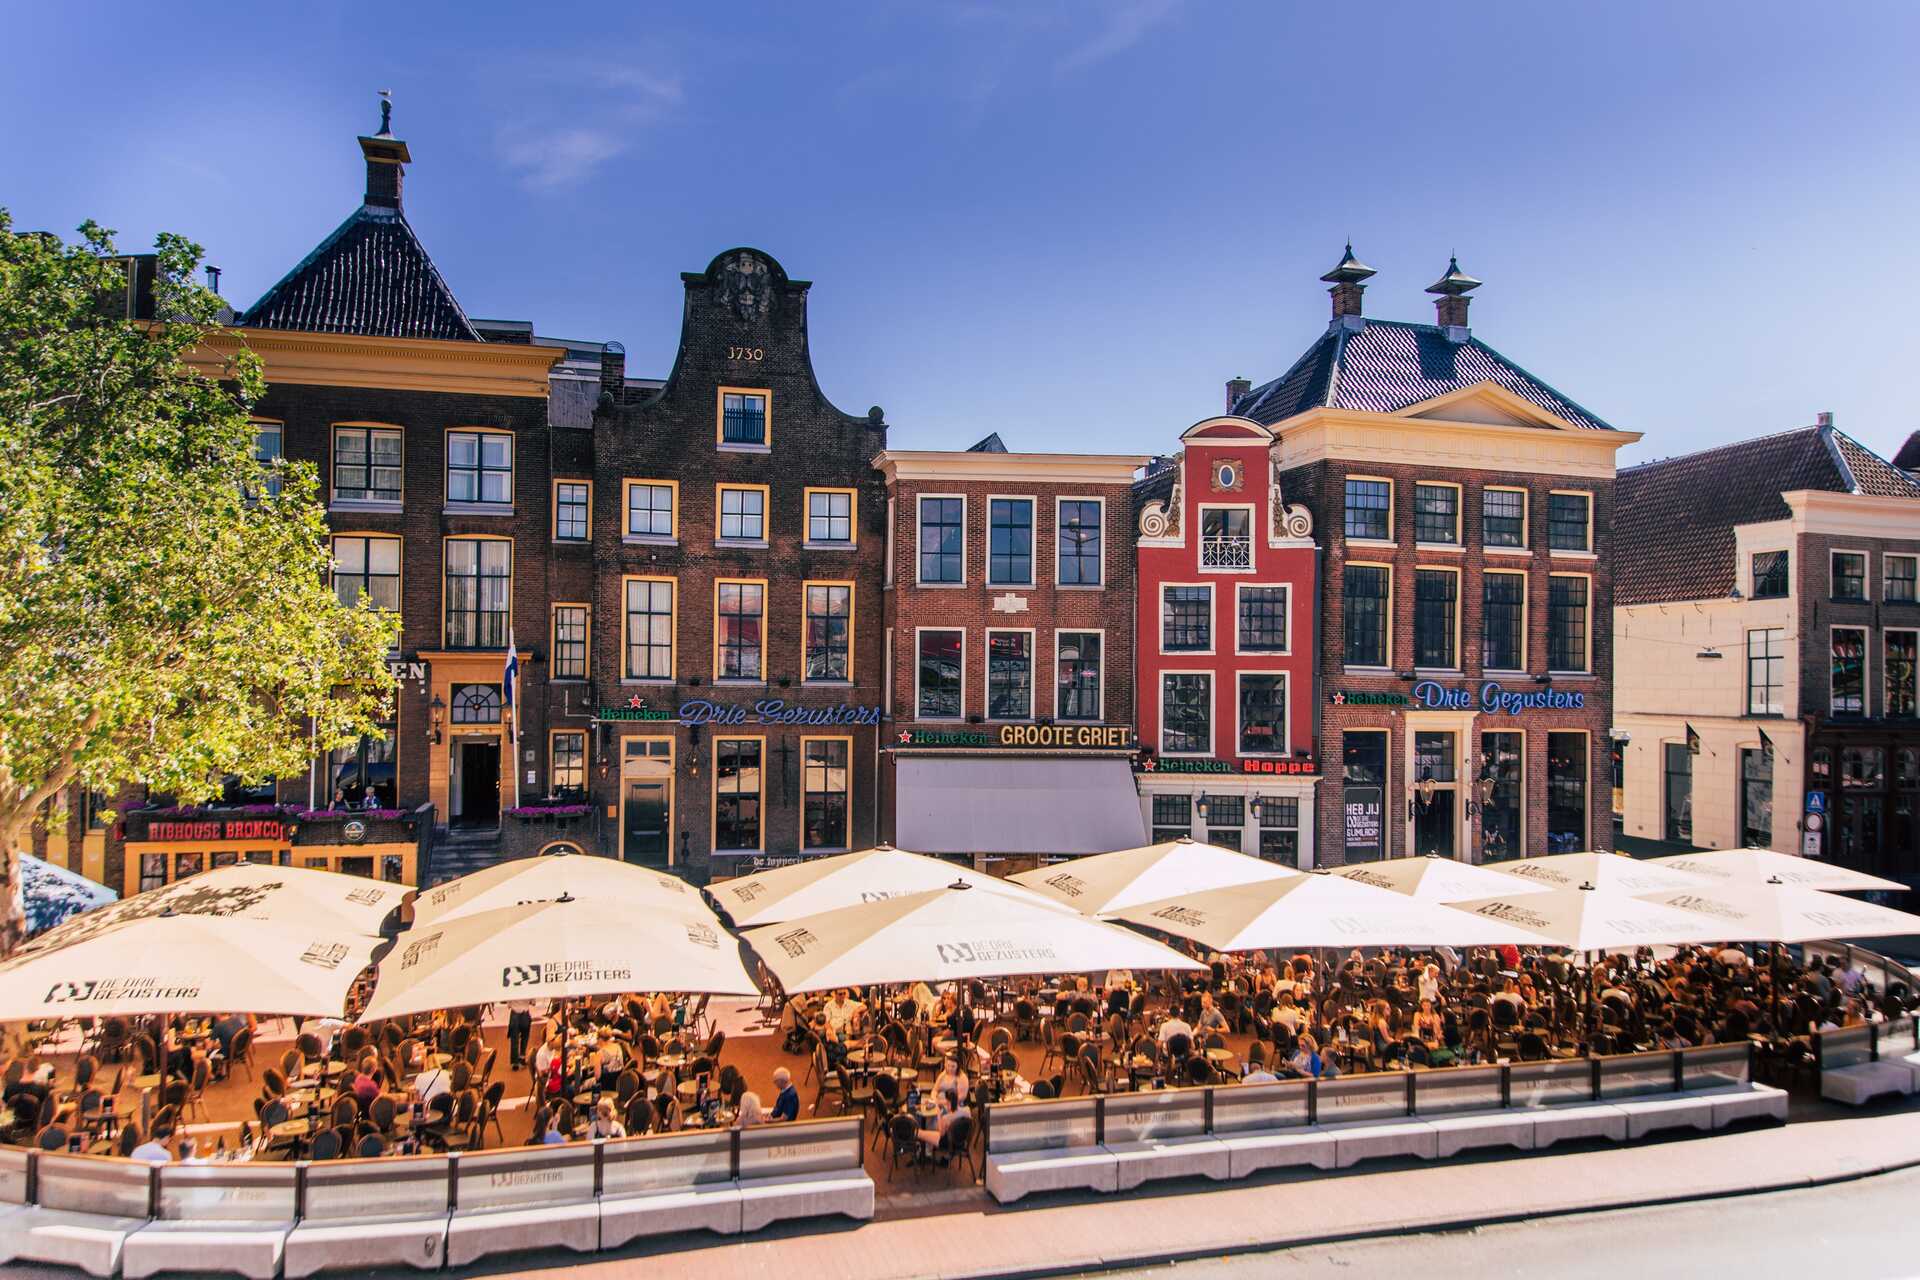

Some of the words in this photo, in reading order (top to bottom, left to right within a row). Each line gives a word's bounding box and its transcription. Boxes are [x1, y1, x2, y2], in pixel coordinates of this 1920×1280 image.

[727, 347, 764, 361] 1730
[1348, 692, 1408, 704] Heineken
[1415, 681, 1472, 708] Drie
[1481, 682, 1585, 715] Gezusters
[600, 708, 671, 721] Heineken
[680, 700, 747, 725] Drie
[755, 700, 881, 725] Gezusters
[914, 730, 987, 744] Heineken
[1000, 726, 1073, 745] GROOTE
[1078, 727, 1129, 745] GRIET
[1159, 759, 1231, 772] Heineken
[1243, 759, 1315, 774] Hoppe
[1346, 803, 1363, 815] HEB
[1365, 803, 1379, 815] JIJ
[148, 823, 221, 840] RIBHOUSE
[225, 822, 280, 839] BRONCO
[976, 948, 1057, 961] GEZUSTERS
[544, 962, 561, 972] DE
[564, 960, 593, 971] DRIE
[544, 969, 632, 984] GEZUSTERS
[94, 988, 199, 1000] GEZUSTERS
